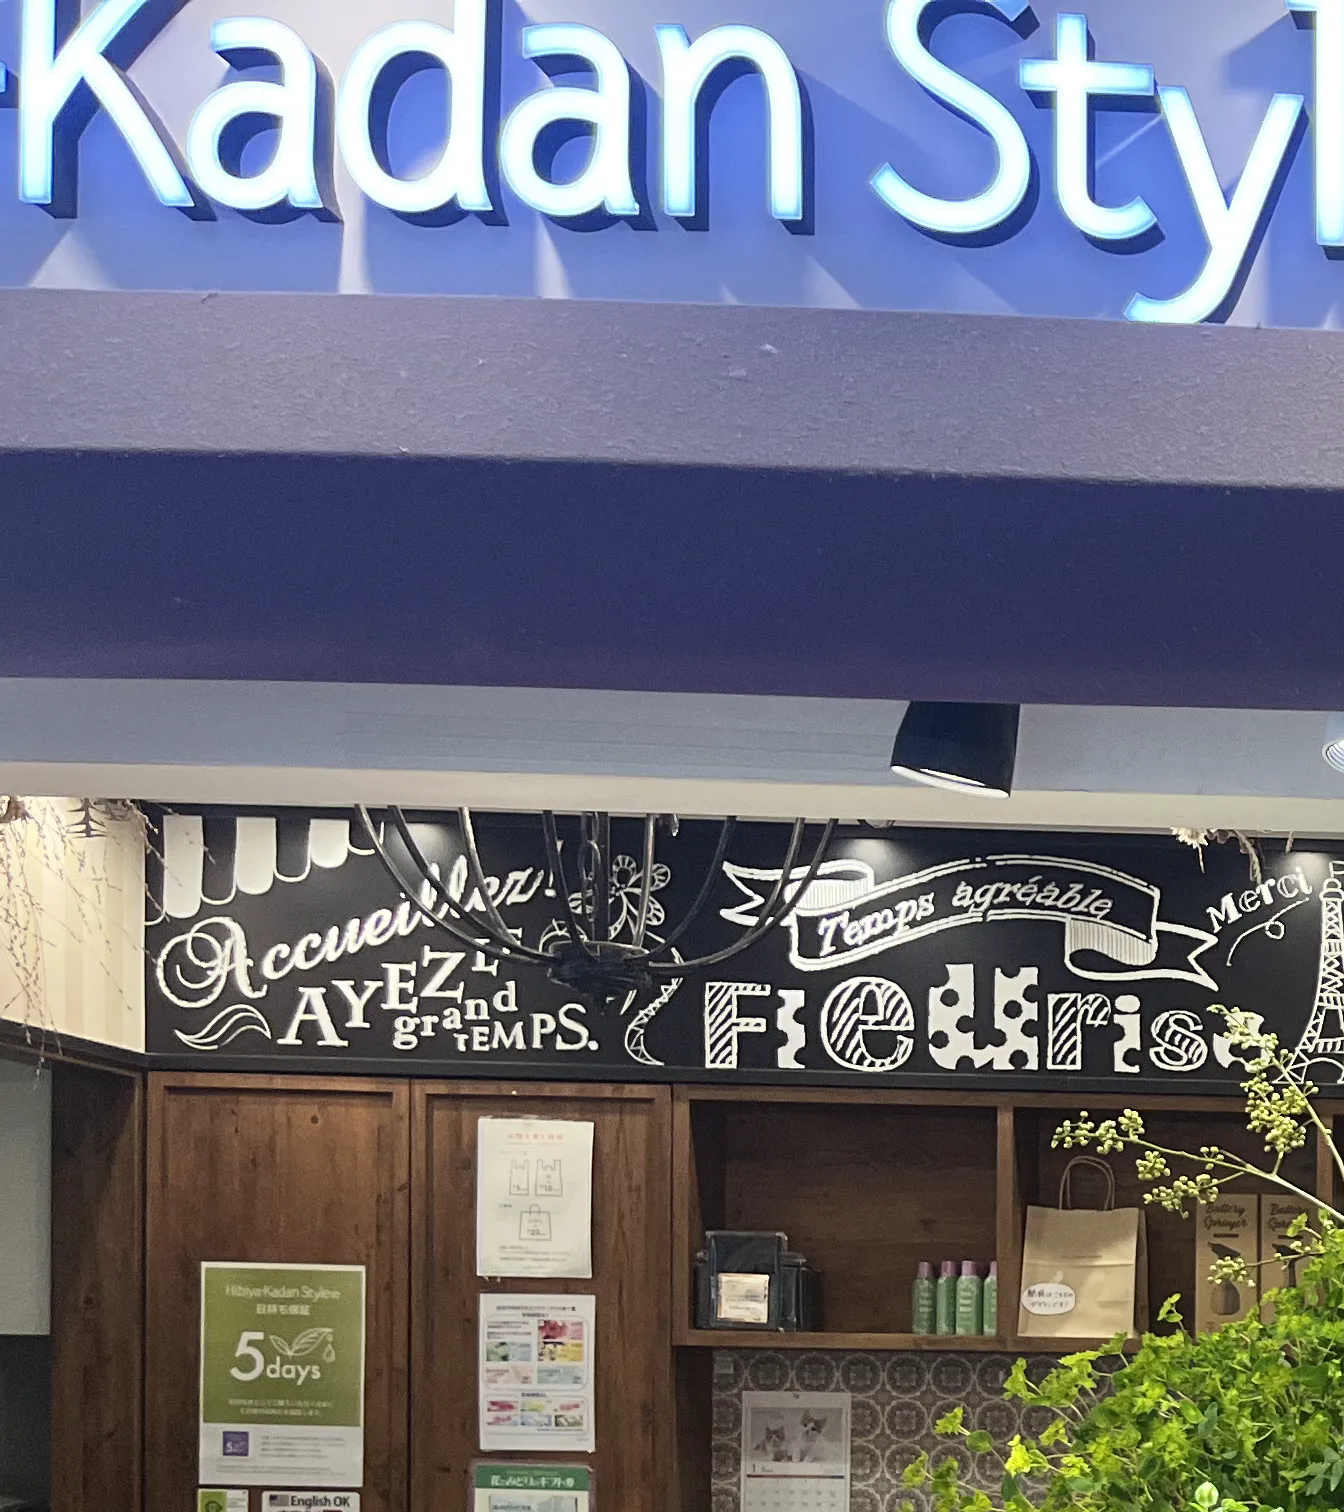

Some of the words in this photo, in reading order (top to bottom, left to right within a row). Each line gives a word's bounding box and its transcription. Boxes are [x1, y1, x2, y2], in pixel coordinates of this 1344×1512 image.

[0, 0, 803, 219] Kadan
[818, 891, 934, 957] Temps
[952, 874, 1113, 921] agréable
[1205, 865, 1313, 934] Merci
[277, 945, 466, 1048] AYEZ
[394, 981, 518, 1051] grand
[1204, 1203, 1246, 1217] Battery
[230, 1331, 265, 1381] 5
[266, 1356, 321, 1385] days
[290, 1495, 331, 1509] English
[333, 1496, 350, 1508] OK
